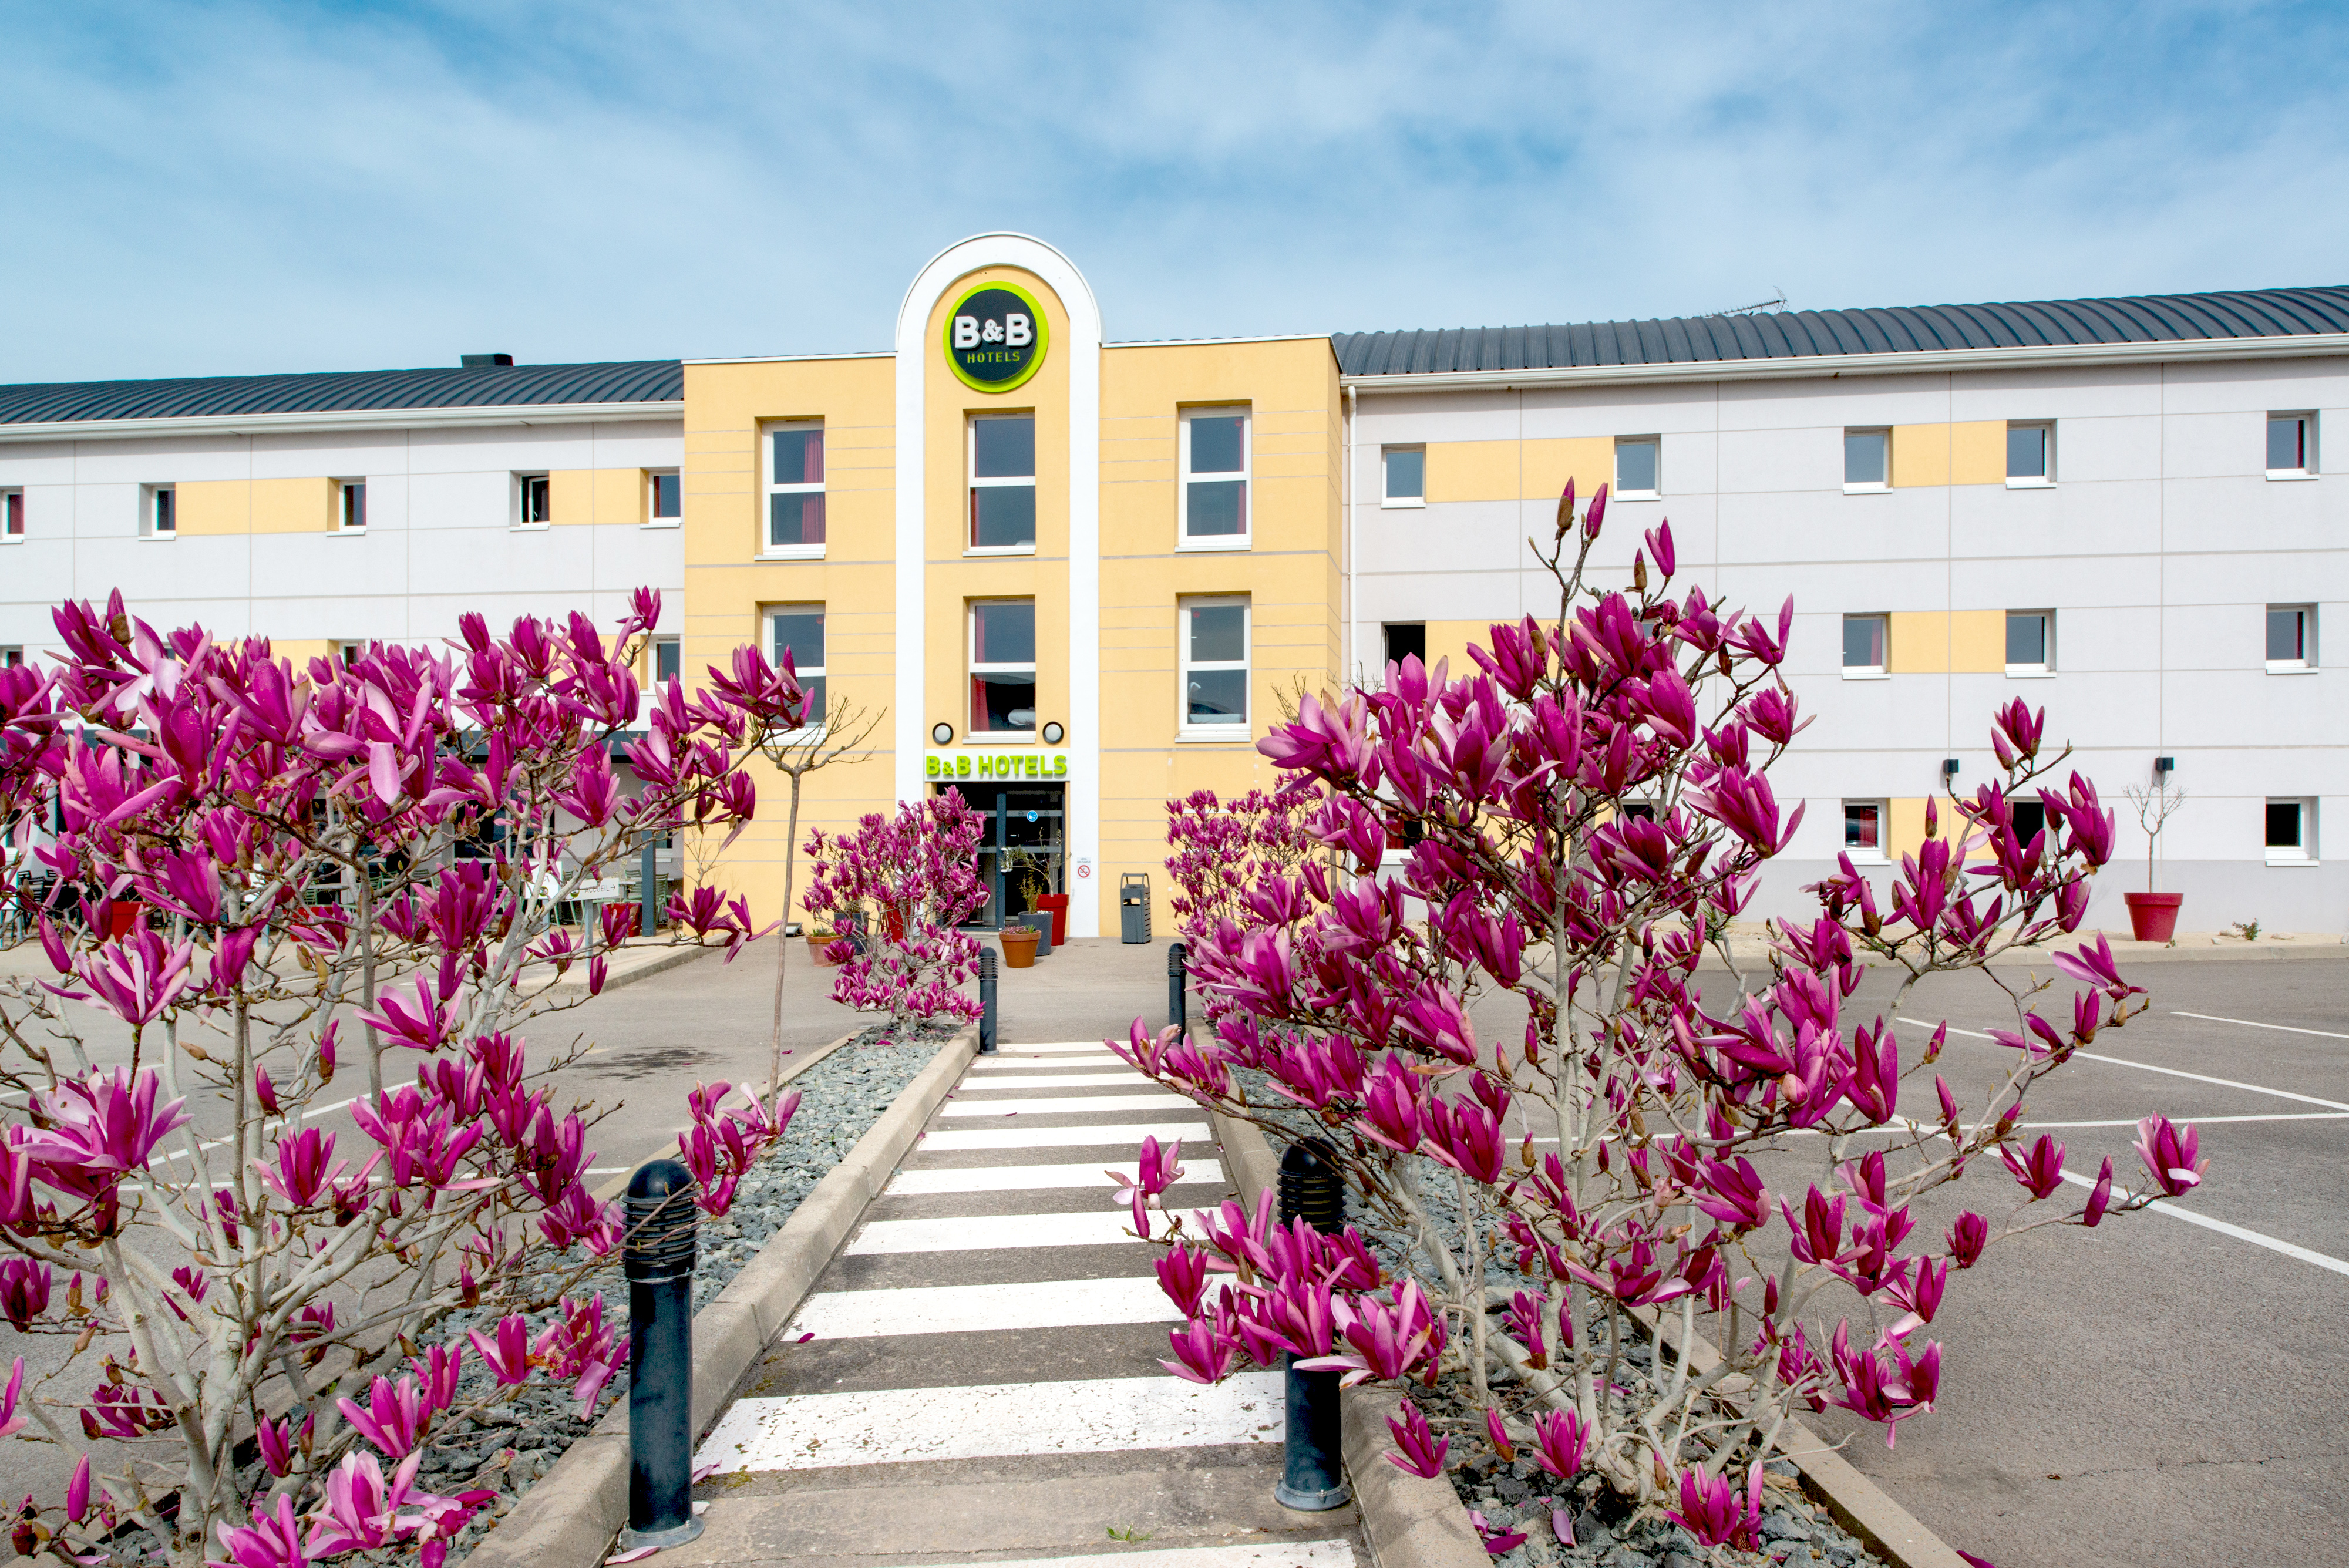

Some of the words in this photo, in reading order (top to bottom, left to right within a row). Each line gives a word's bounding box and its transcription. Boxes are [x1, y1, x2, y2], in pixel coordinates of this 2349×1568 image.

[955, 313, 1032, 349] B&B
[967, 351, 1021, 364] HOTELS
[926, 755, 971, 775] B&B
[978, 755, 1068, 775] HOTELS
[585, 884, 610, 893] ACCUEIL
